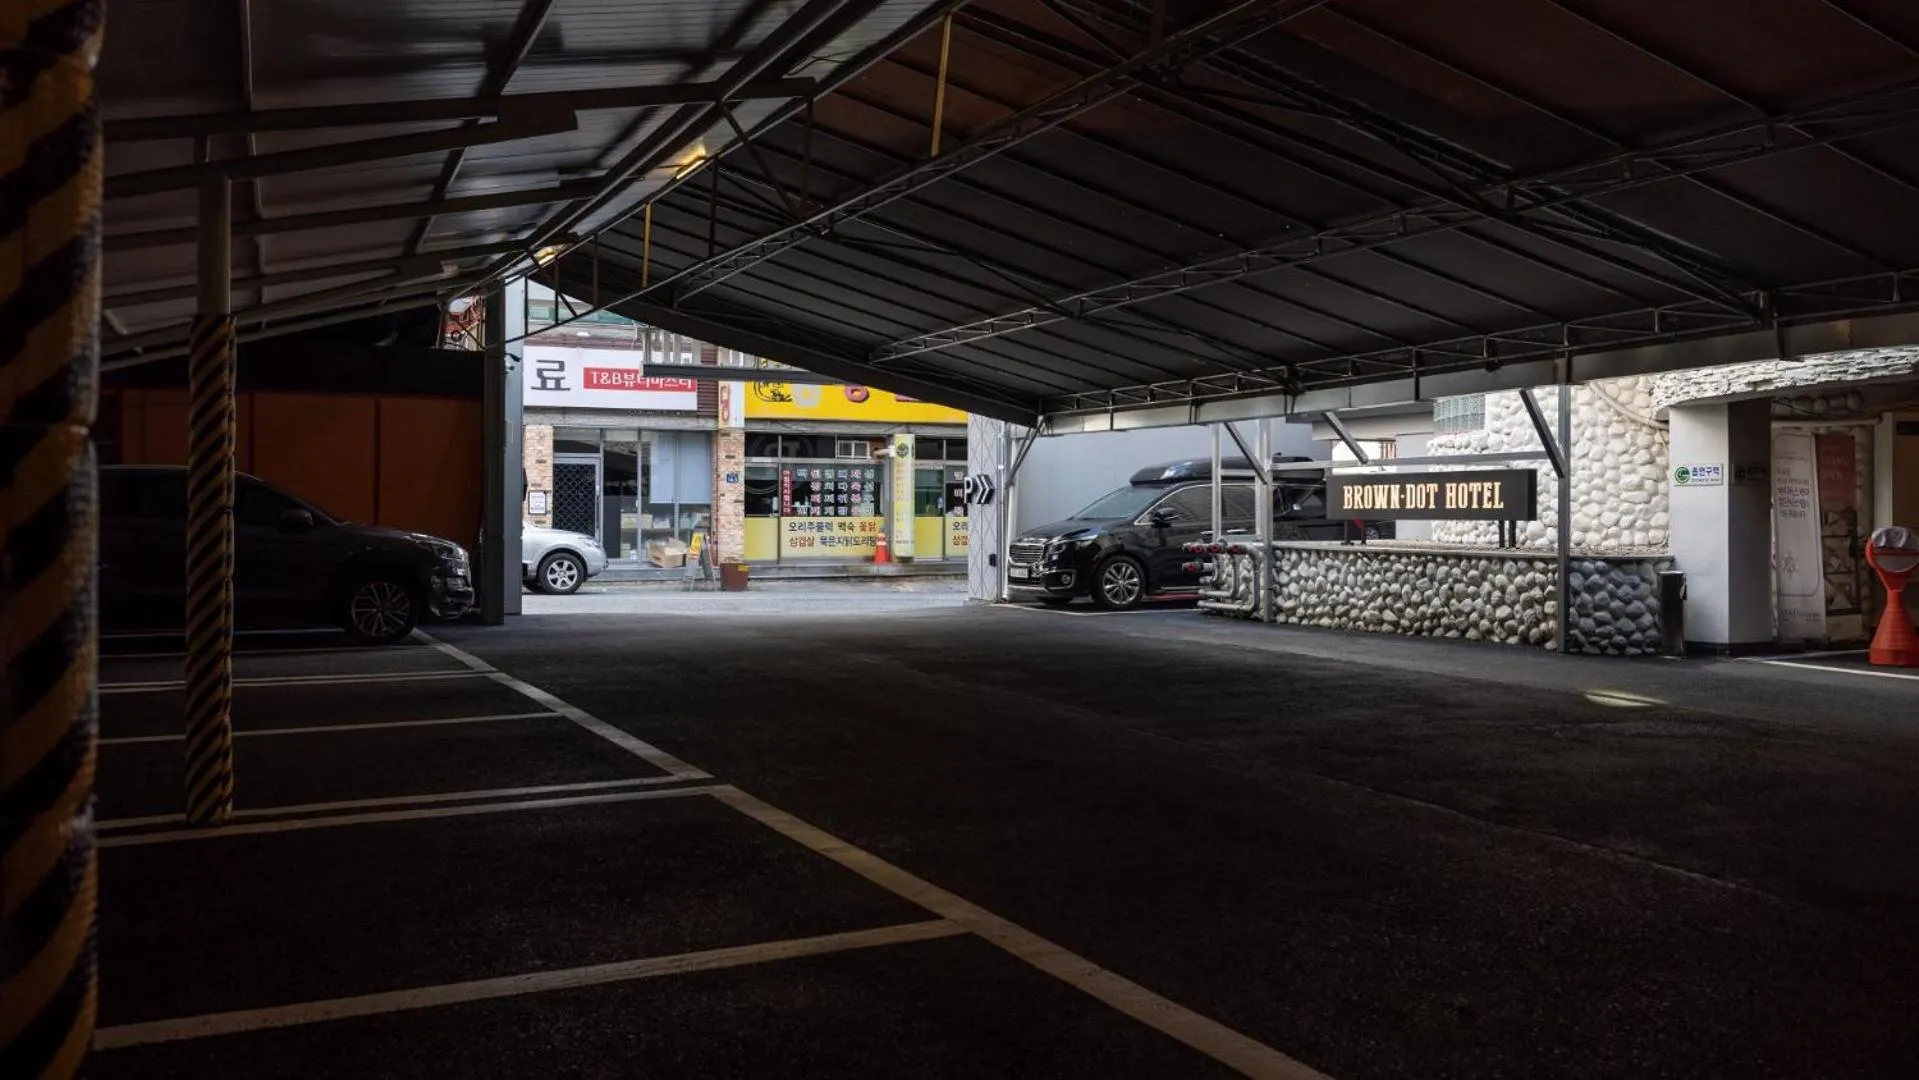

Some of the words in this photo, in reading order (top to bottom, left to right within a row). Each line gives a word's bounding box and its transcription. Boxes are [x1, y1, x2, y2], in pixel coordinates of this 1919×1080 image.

[964, 476, 973, 504] P
[1445, 482, 1504, 509] HOTEL
[837, 521, 856, 532] 백숙
[789, 535, 815, 548] 삼겹살
